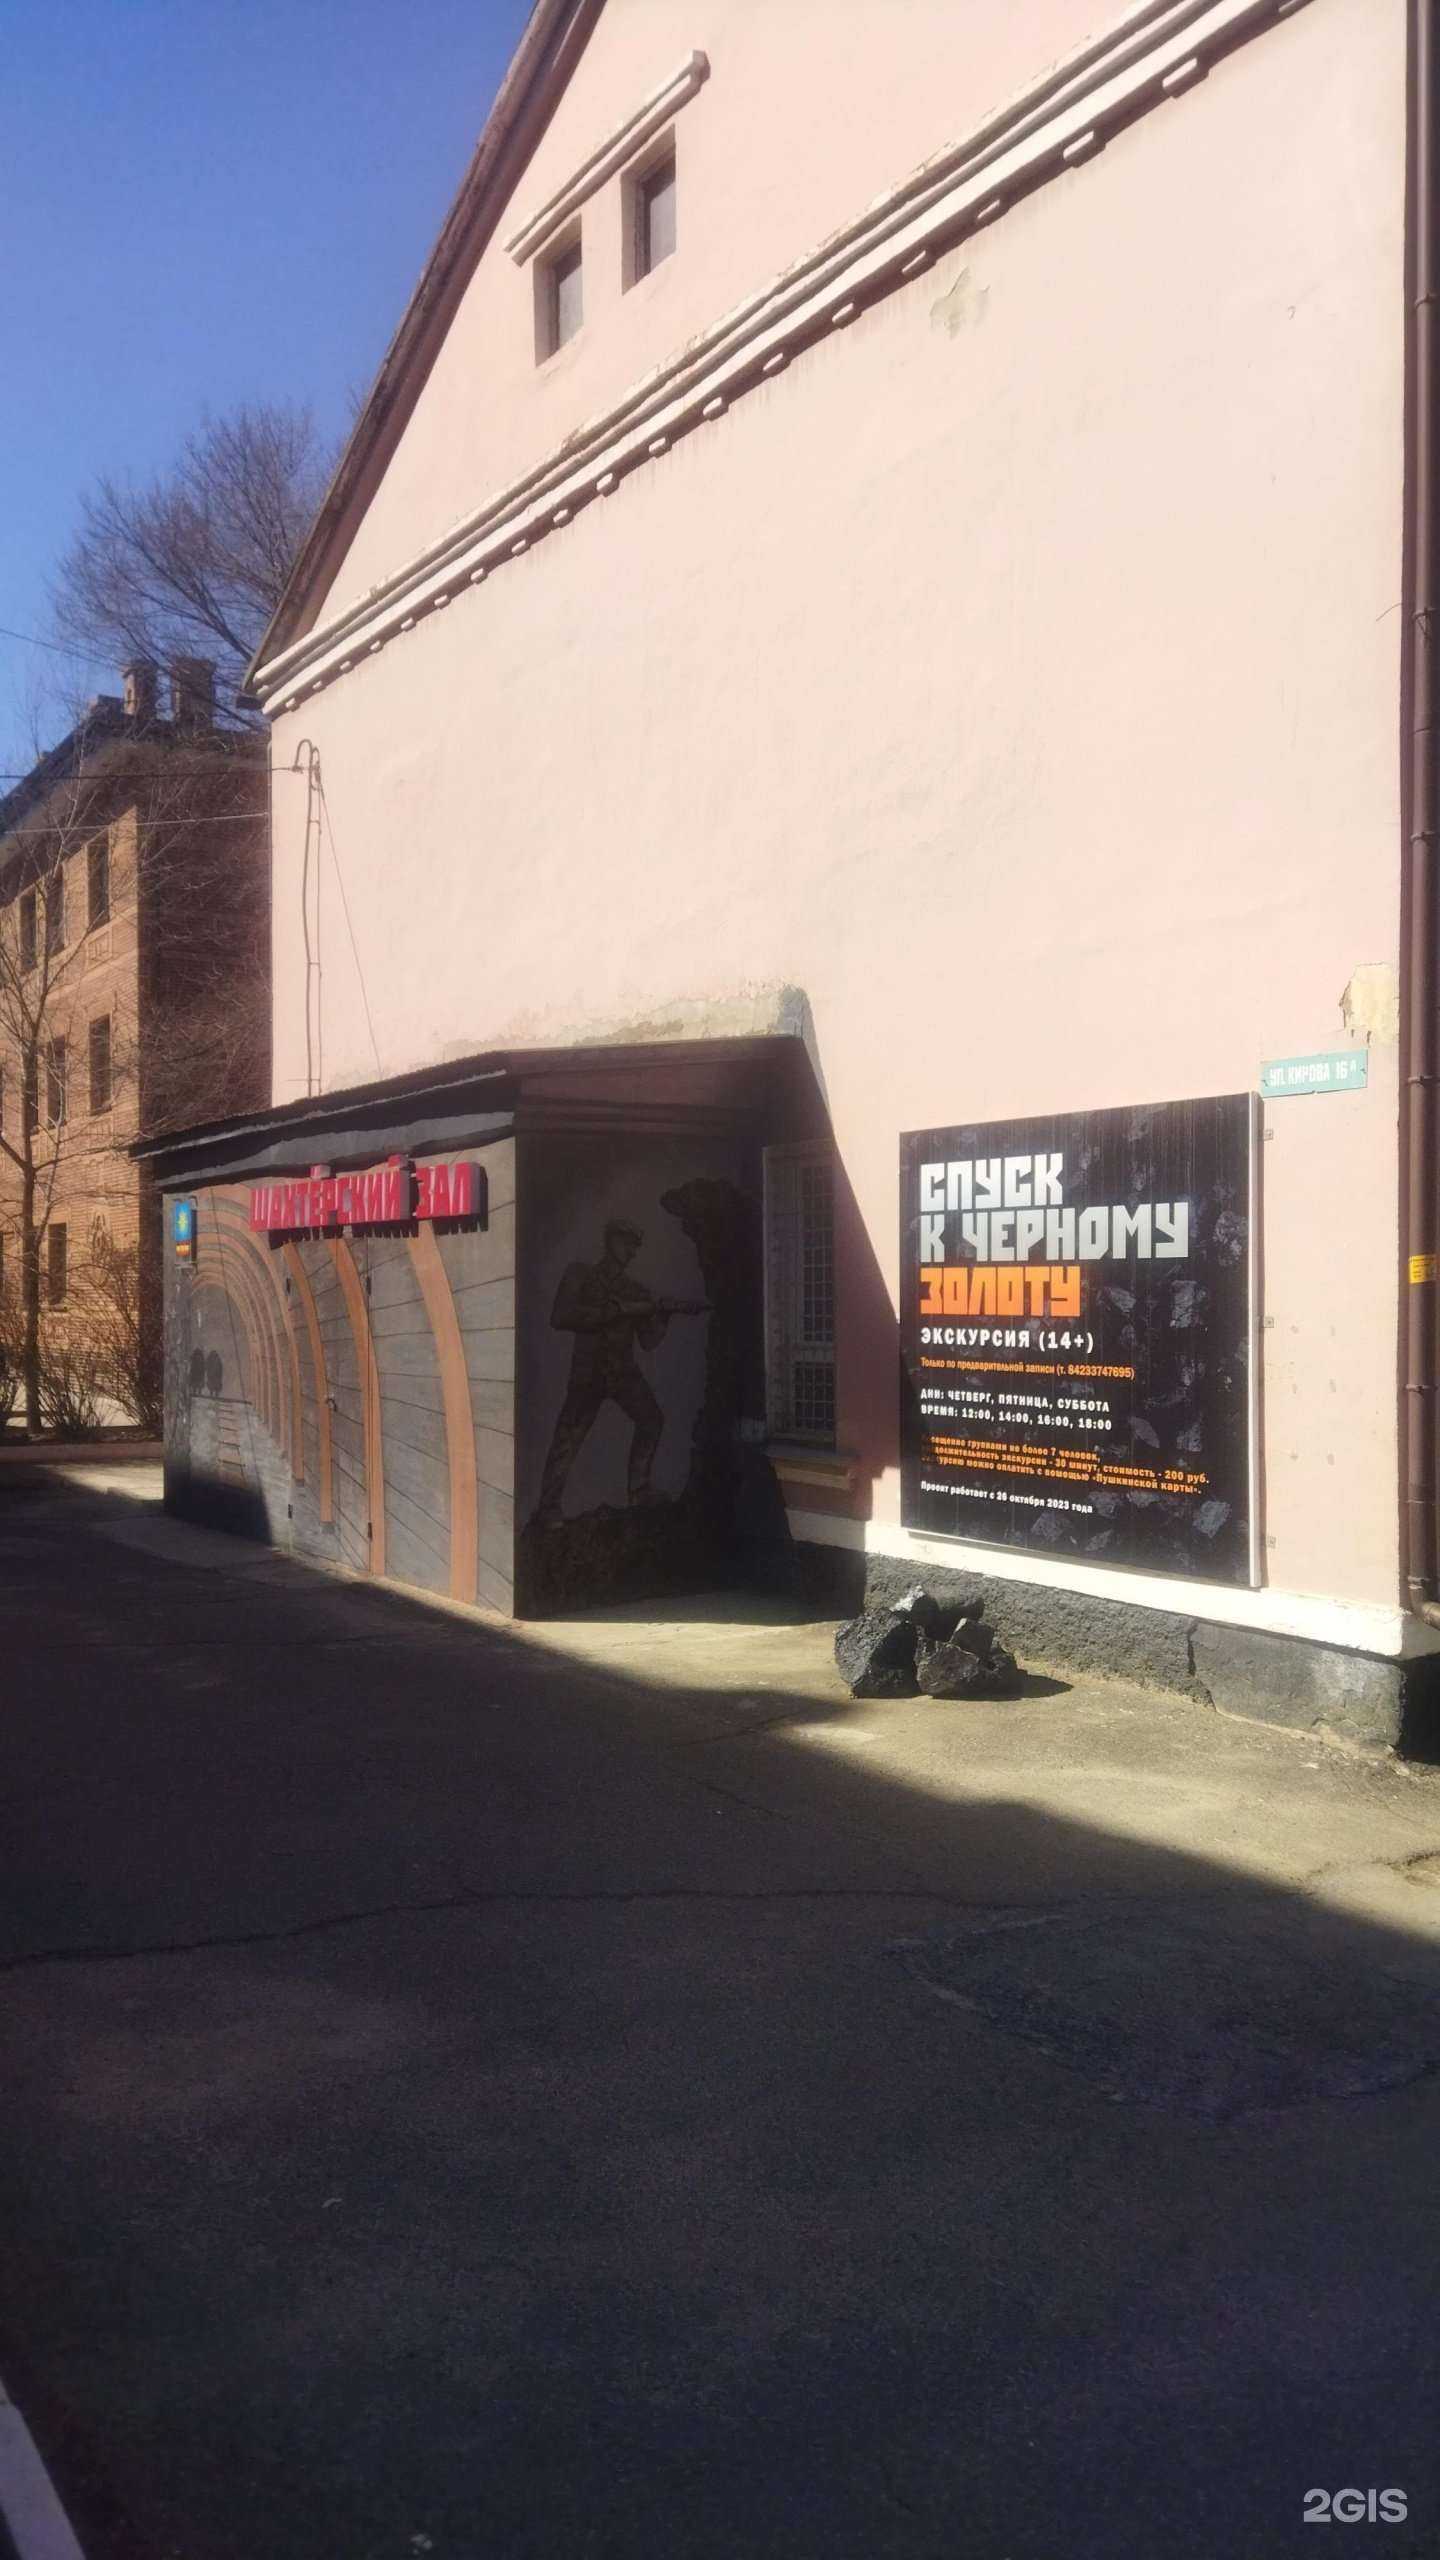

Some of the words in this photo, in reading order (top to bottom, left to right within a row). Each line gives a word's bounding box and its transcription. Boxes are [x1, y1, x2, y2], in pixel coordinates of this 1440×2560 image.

[1288, 1062, 1331, 1085] КИРОВА
[415, 1161, 478, 1220] ЗАЛ
[920, 1153, 1063, 1212] СПУСК
[920, 1214, 945, 1263] К
[962, 1202, 1189, 1262] ЧЕРНОМУ
[920, 1266, 1080, 1317] ЗОЛОТУ
[920, 1327, 1030, 1348] ЭКСКУРСИЯ
[1039, 1331, 1094, 1354] (14+)
[920, 1356, 945, 1368] Только
[946, 1360, 956, 1368] по
[957, 1360, 1024, 1372] предварительной
[1025, 1364, 1055, 1374] записи
[1056, 1363, 1067, 1377] (т.
[920, 1388, 945, 1399] ДНИ:
[947, 1390, 995, 1405] ЧЕТВЕРГ,
[998, 1394, 1053, 1410] ПЯТНИЦА,
[1057, 1398, 1110, 1412] СУББОТА
[920, 1404, 958, 1417] ВРЕМЯ:
[962, 1408, 995, 1422] 12:00,
[999, 1411, 1033, 1425] 14:00,
[1037, 1414, 1074, 1429] 16:00,
[1078, 1418, 1112, 1431] 18:00
[967, 1439, 1007, 1451] группами
[1009, 1444, 1020, 1452] не
[1022, 1444, 1048, 1455] более
[1051, 1447, 1056, 1456] 7
[1059, 1450, 1100, 1463] человек,
[966, 1460, 994, 1470] можно
[996, 1463, 1035, 1474] оплатить
[1045, 1469, 1089, 1481] помощью
[1002, 1453, 1047, 1466] экскурсии
[1055, 1458, 1066, 1467] 30
[1069, 1461, 1100, 1474] минут,
[1103, 1465, 1156, 1478] стоимость
[1164, 1470, 1184, 1480] 200
[1187, 1473, 1209, 1484] руб.
[920, 1481, 949, 1493] Проект
[950, 1486, 988, 1498] работает
[1009, 1495, 1045, 1507] октября
[1047, 1498, 1069, 1510] 2023
[1071, 1503, 1093, 1513] года
